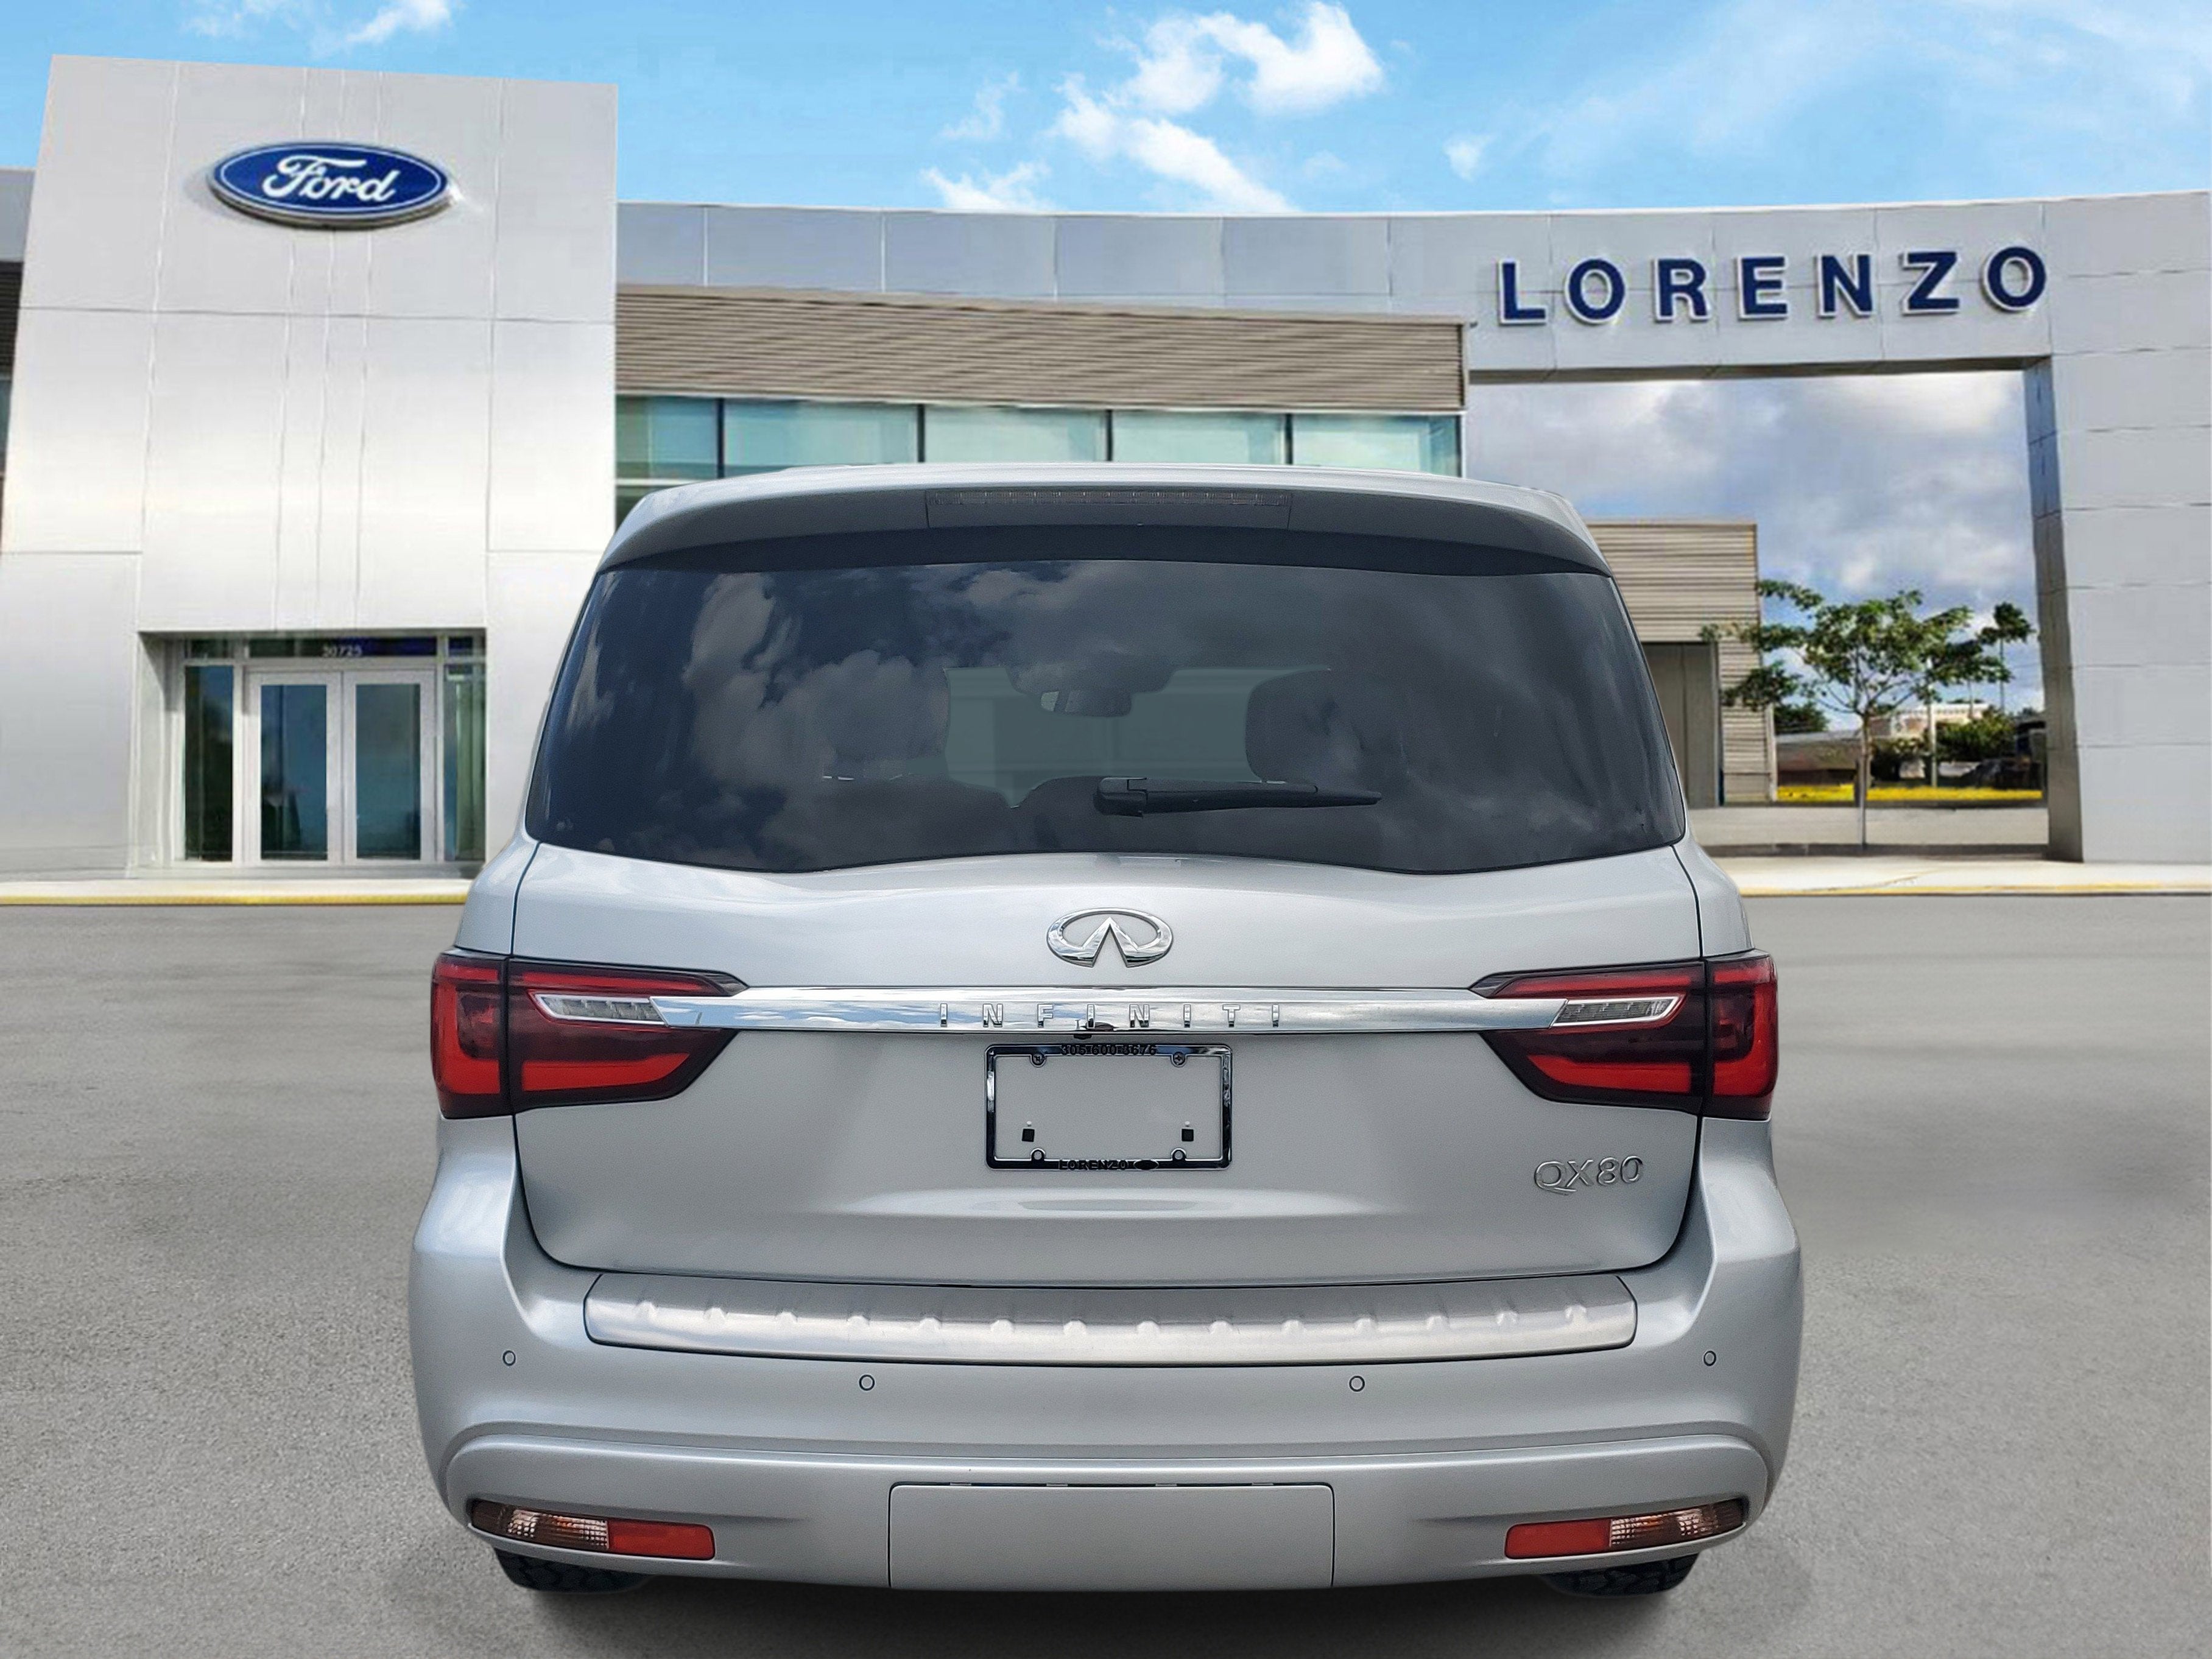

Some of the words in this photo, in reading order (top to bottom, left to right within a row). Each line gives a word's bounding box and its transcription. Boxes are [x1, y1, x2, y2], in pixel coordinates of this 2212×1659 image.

[262, 155, 400, 201] Ford
[1499, 246, 2047, 323] LORENZO
[939, 1003, 1280, 1027] INFINITI
[1058, 1160, 1128, 1170] LORENZO
[1534, 1155, 1643, 1196] QX80
